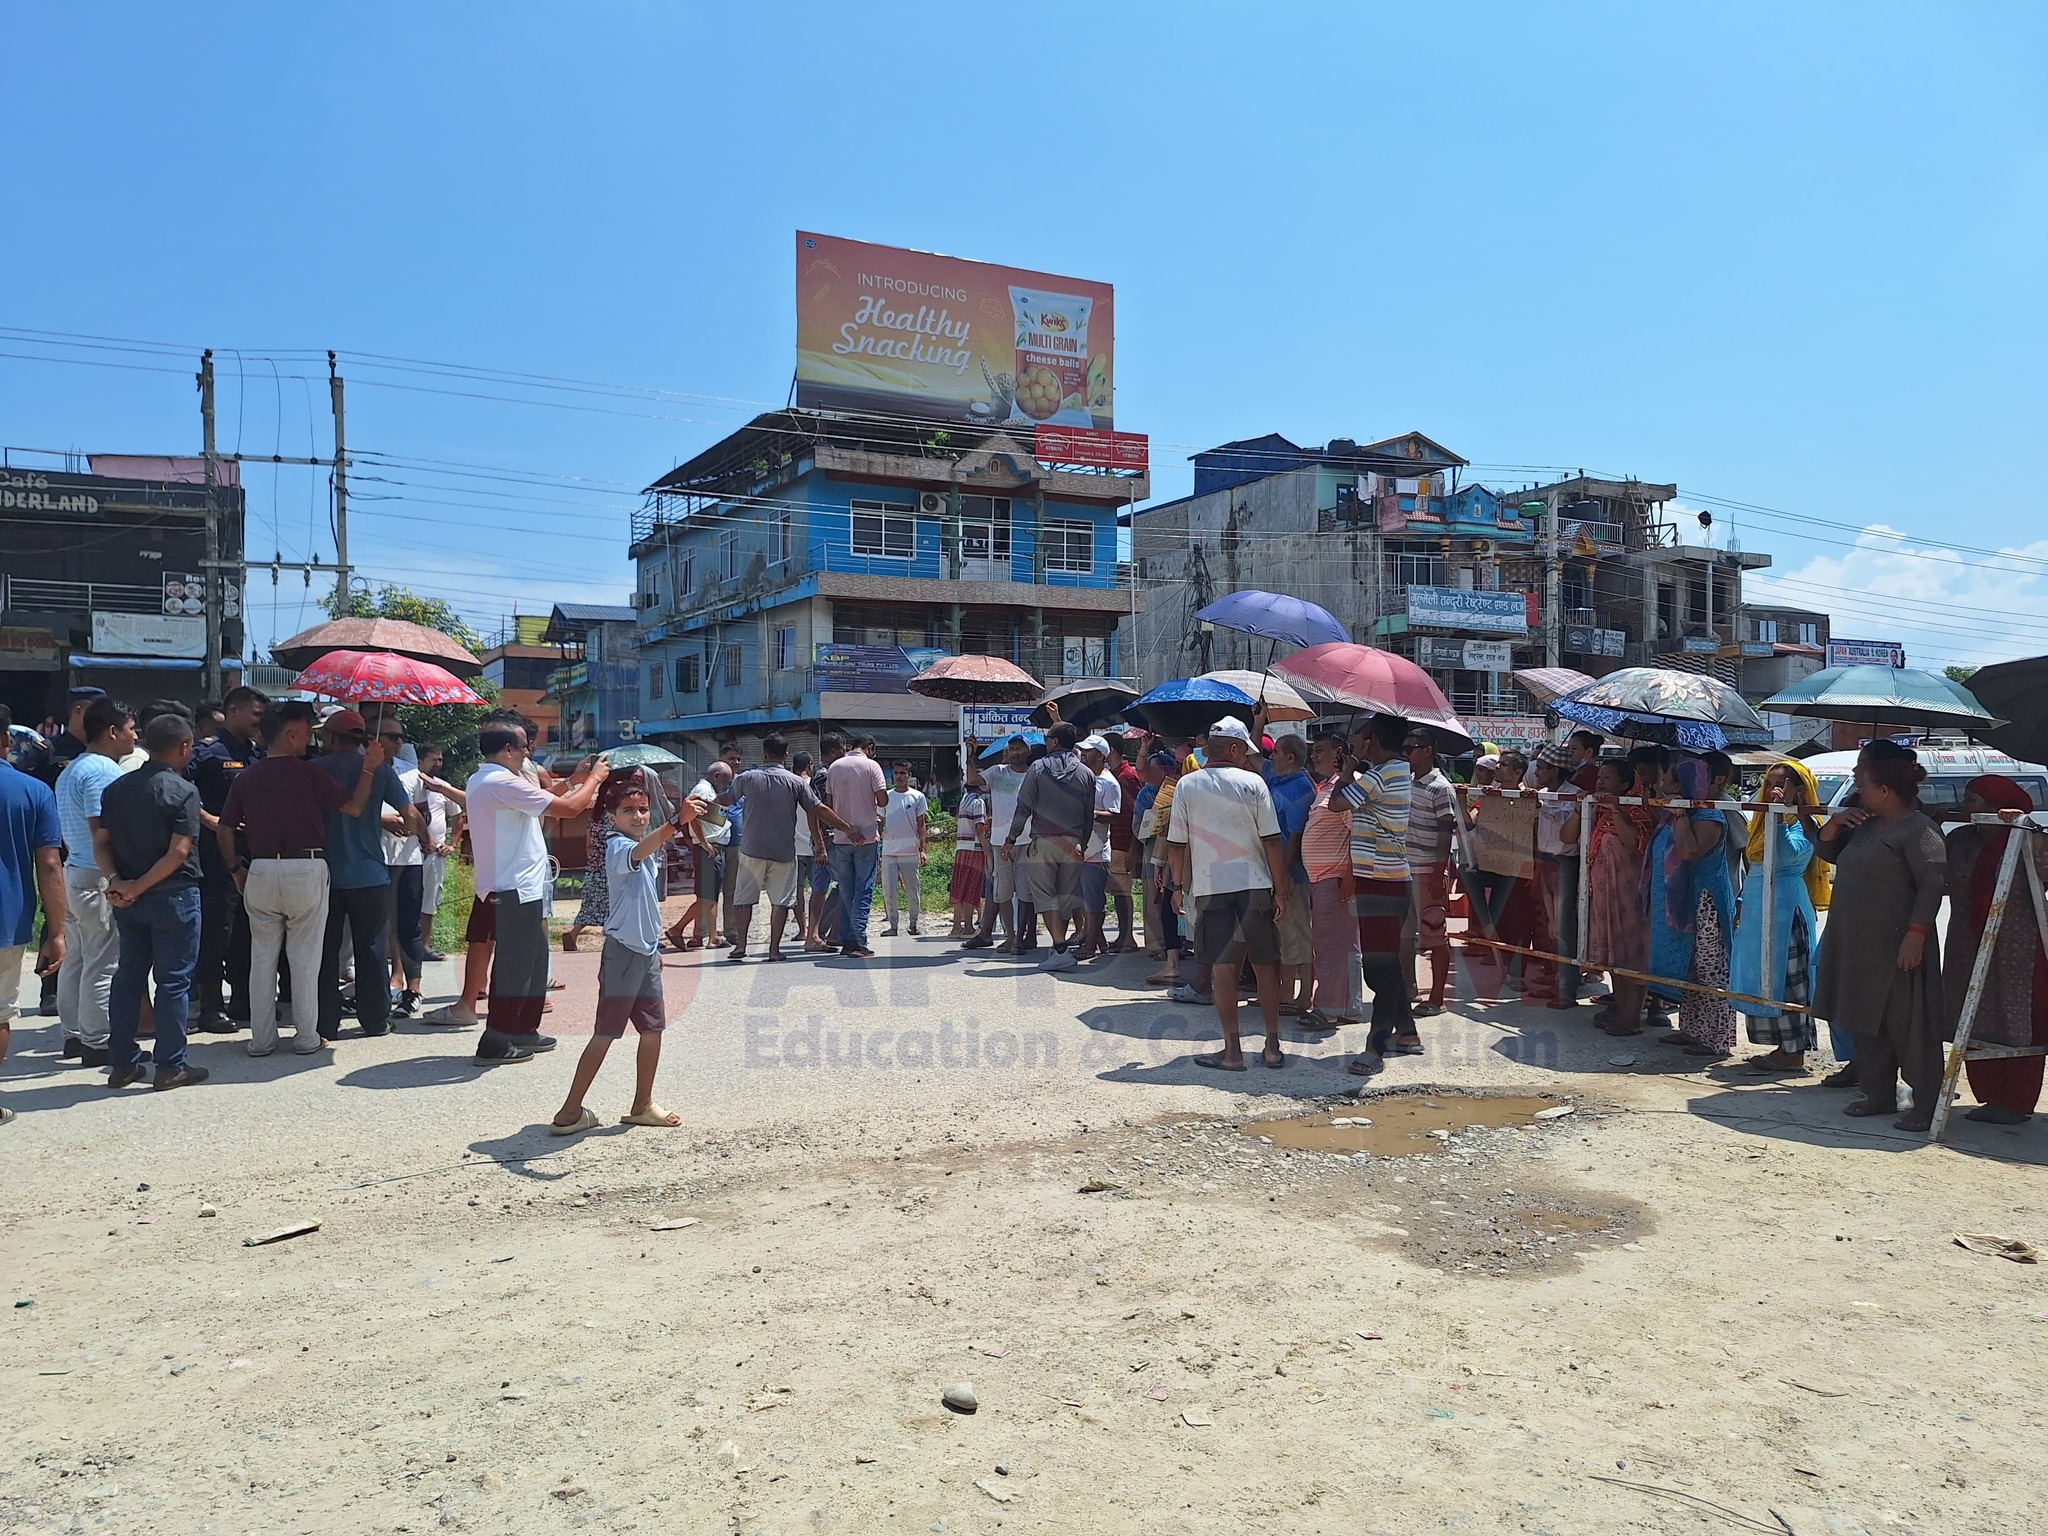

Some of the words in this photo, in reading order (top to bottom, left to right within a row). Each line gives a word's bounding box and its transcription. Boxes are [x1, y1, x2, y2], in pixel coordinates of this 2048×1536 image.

[857, 272, 967, 302] INTRODUCING
[855, 295, 971, 348] Healthy
[1040, 312, 1066, 332] Kwiks
[832, 322, 972, 377] Snacking
[1028, 332, 1052, 349] MULTI
[1053, 336, 1078, 353] GRAIN
[1025, 353, 1057, 366] cheese
[1059, 357, 1080, 369] balls
[1440, 594, 1463, 609] तन्दुरी
[979, 710, 1008, 723] अंकित
[1010, 713, 1031, 725] तन्दु
